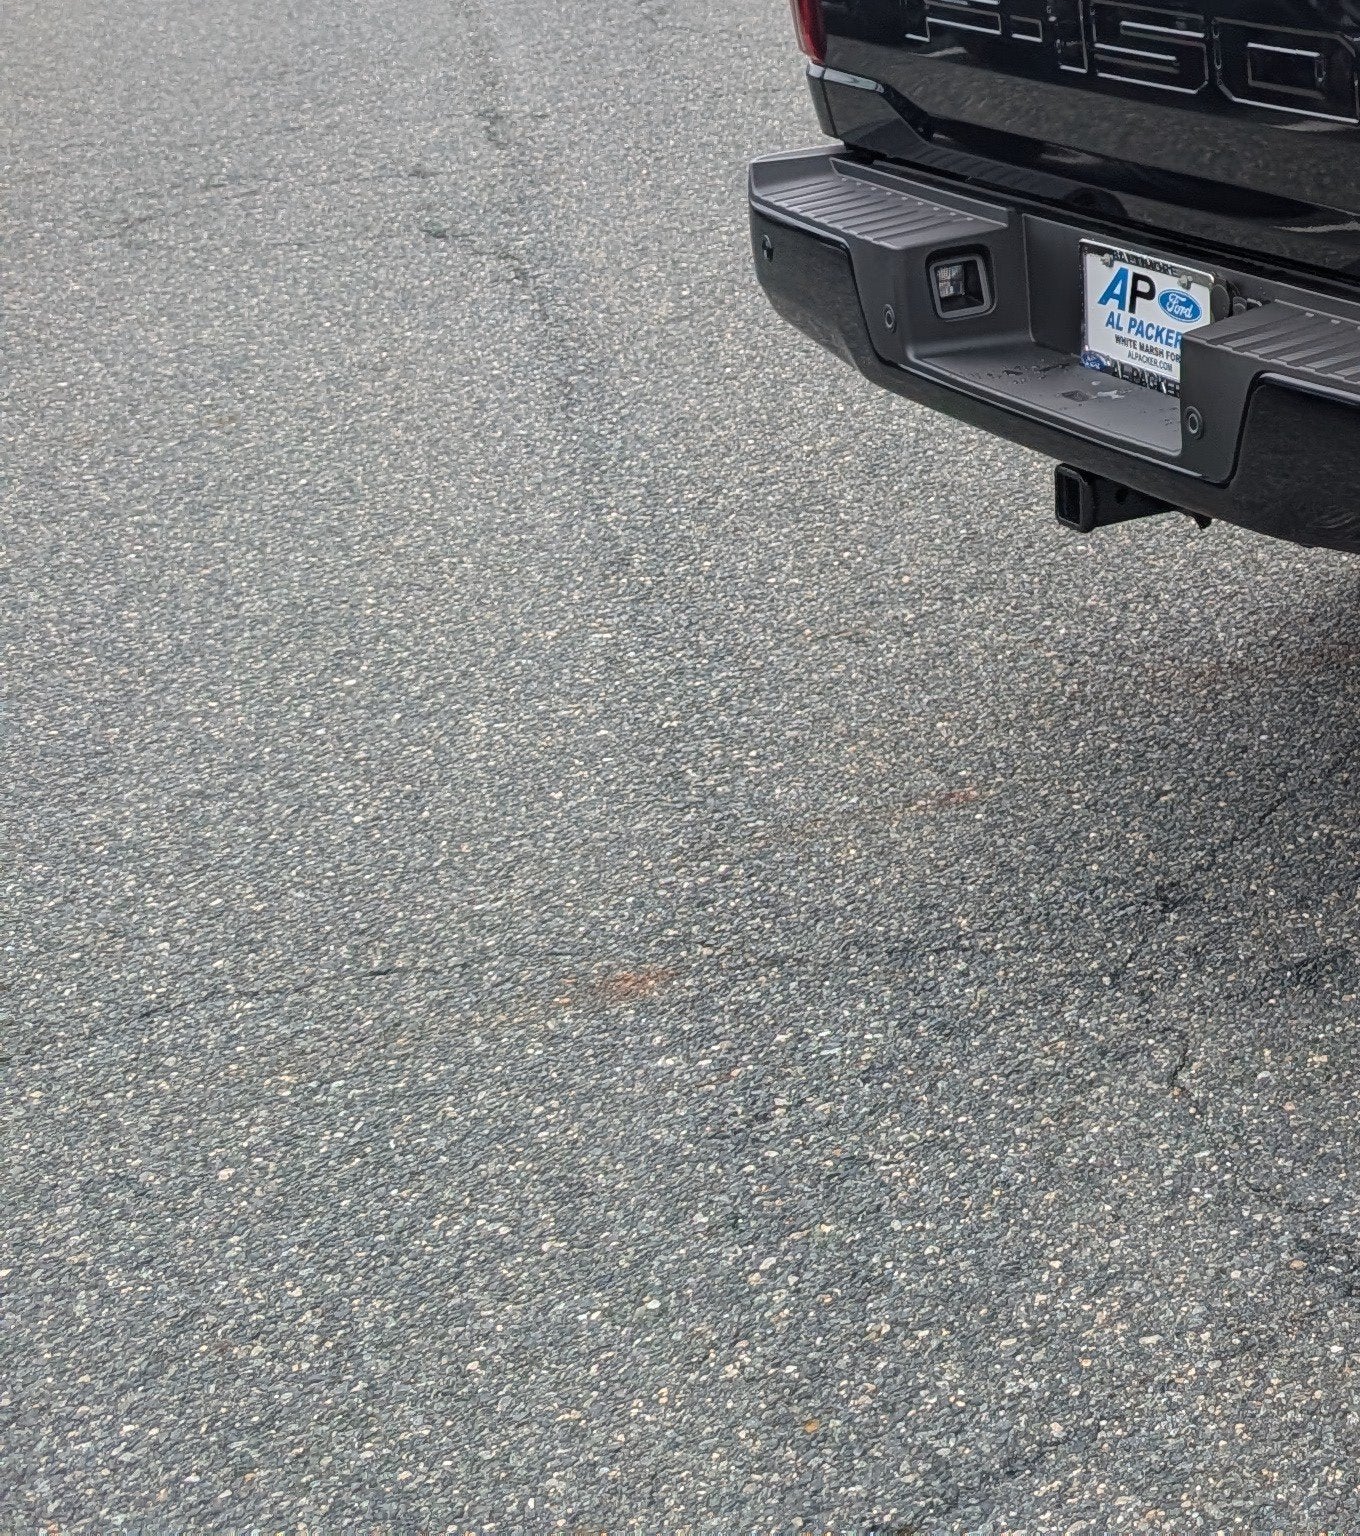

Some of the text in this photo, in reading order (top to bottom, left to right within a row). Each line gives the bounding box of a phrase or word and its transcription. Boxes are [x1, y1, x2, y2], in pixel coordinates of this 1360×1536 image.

[1097, 266, 1194, 319] AP Ford
[1105, 311, 1124, 332] AL
[1115, 333, 1138, 350] WHITE
[1139, 340, 1164, 358] MARSH
